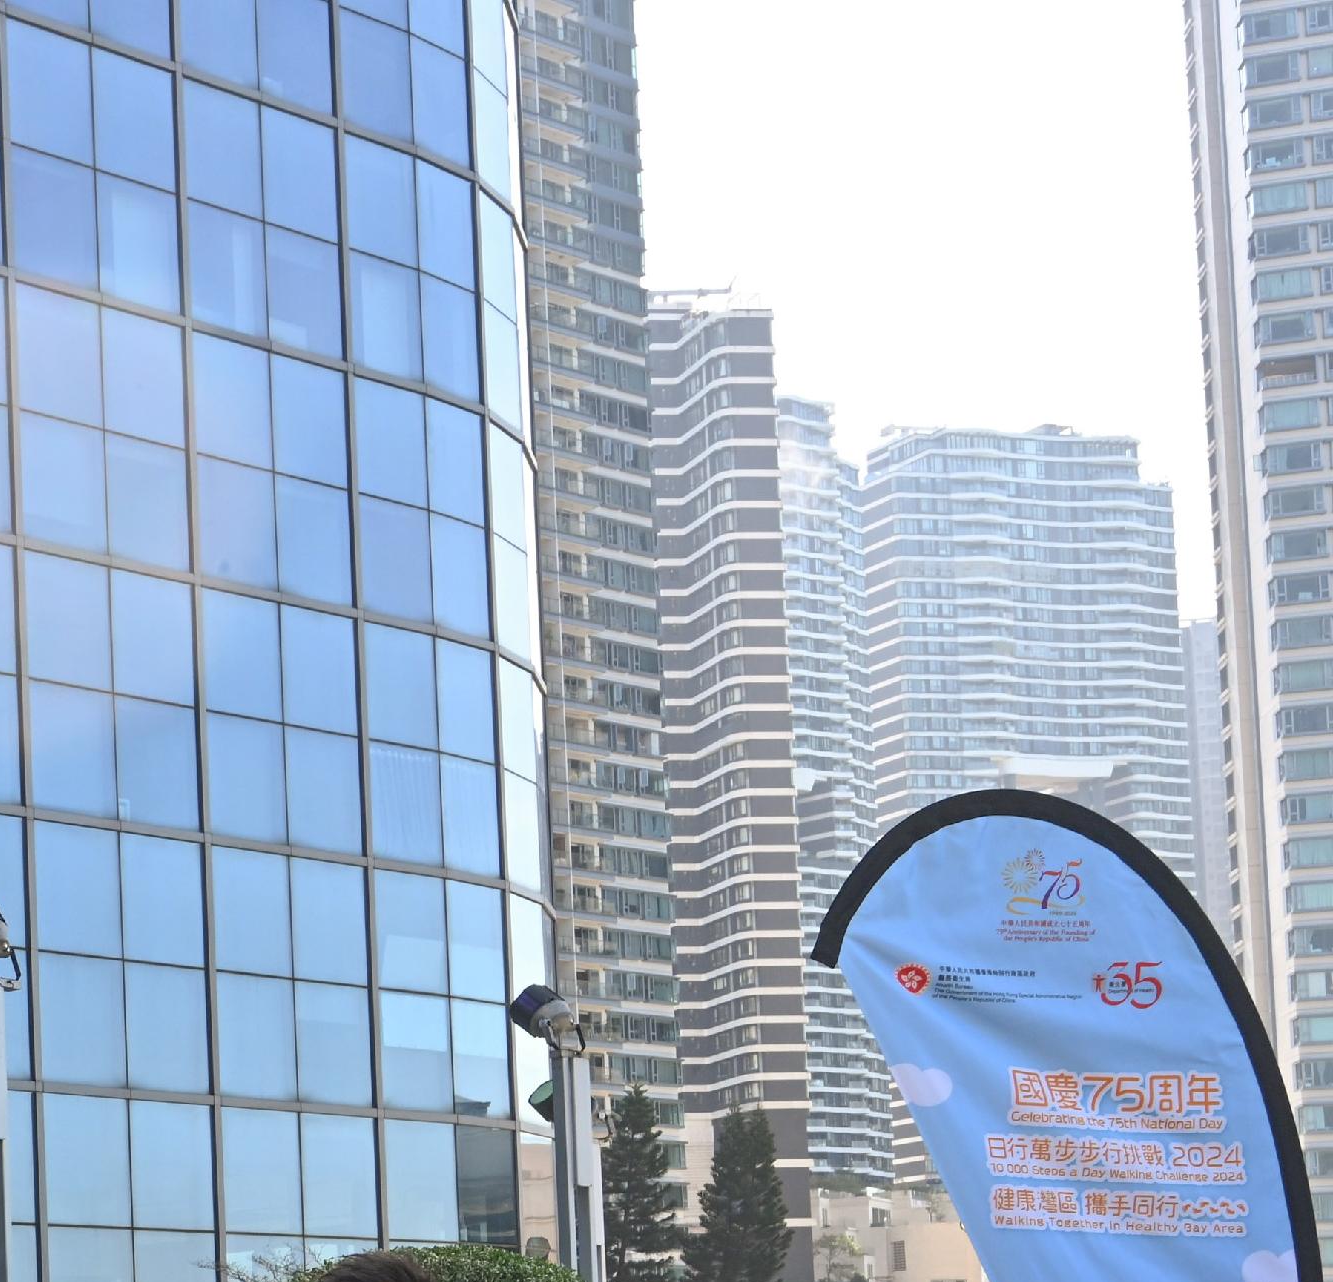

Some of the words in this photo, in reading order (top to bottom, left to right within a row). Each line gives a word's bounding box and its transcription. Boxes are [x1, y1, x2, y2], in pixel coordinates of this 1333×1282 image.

[1039, 859, 1082, 909] 75
[1012, 1069, 1221, 1114] 國慶75周年
[1011, 1111, 1085, 1127] Celebrating
[1088, 1117, 1105, 1127] the
[1108, 1117, 1137, 1129] 75th
[1141, 1118, 1195, 1130] National
[1199, 1118, 1223, 1131] Day
[988, 1137, 1164, 1166] 日行萬步步行挑戰
[1172, 1146, 1242, 1167] 2024
[993, 1188, 1077, 1214] 健康灣區
[1085, 1193, 1178, 1218] 攜手同行
